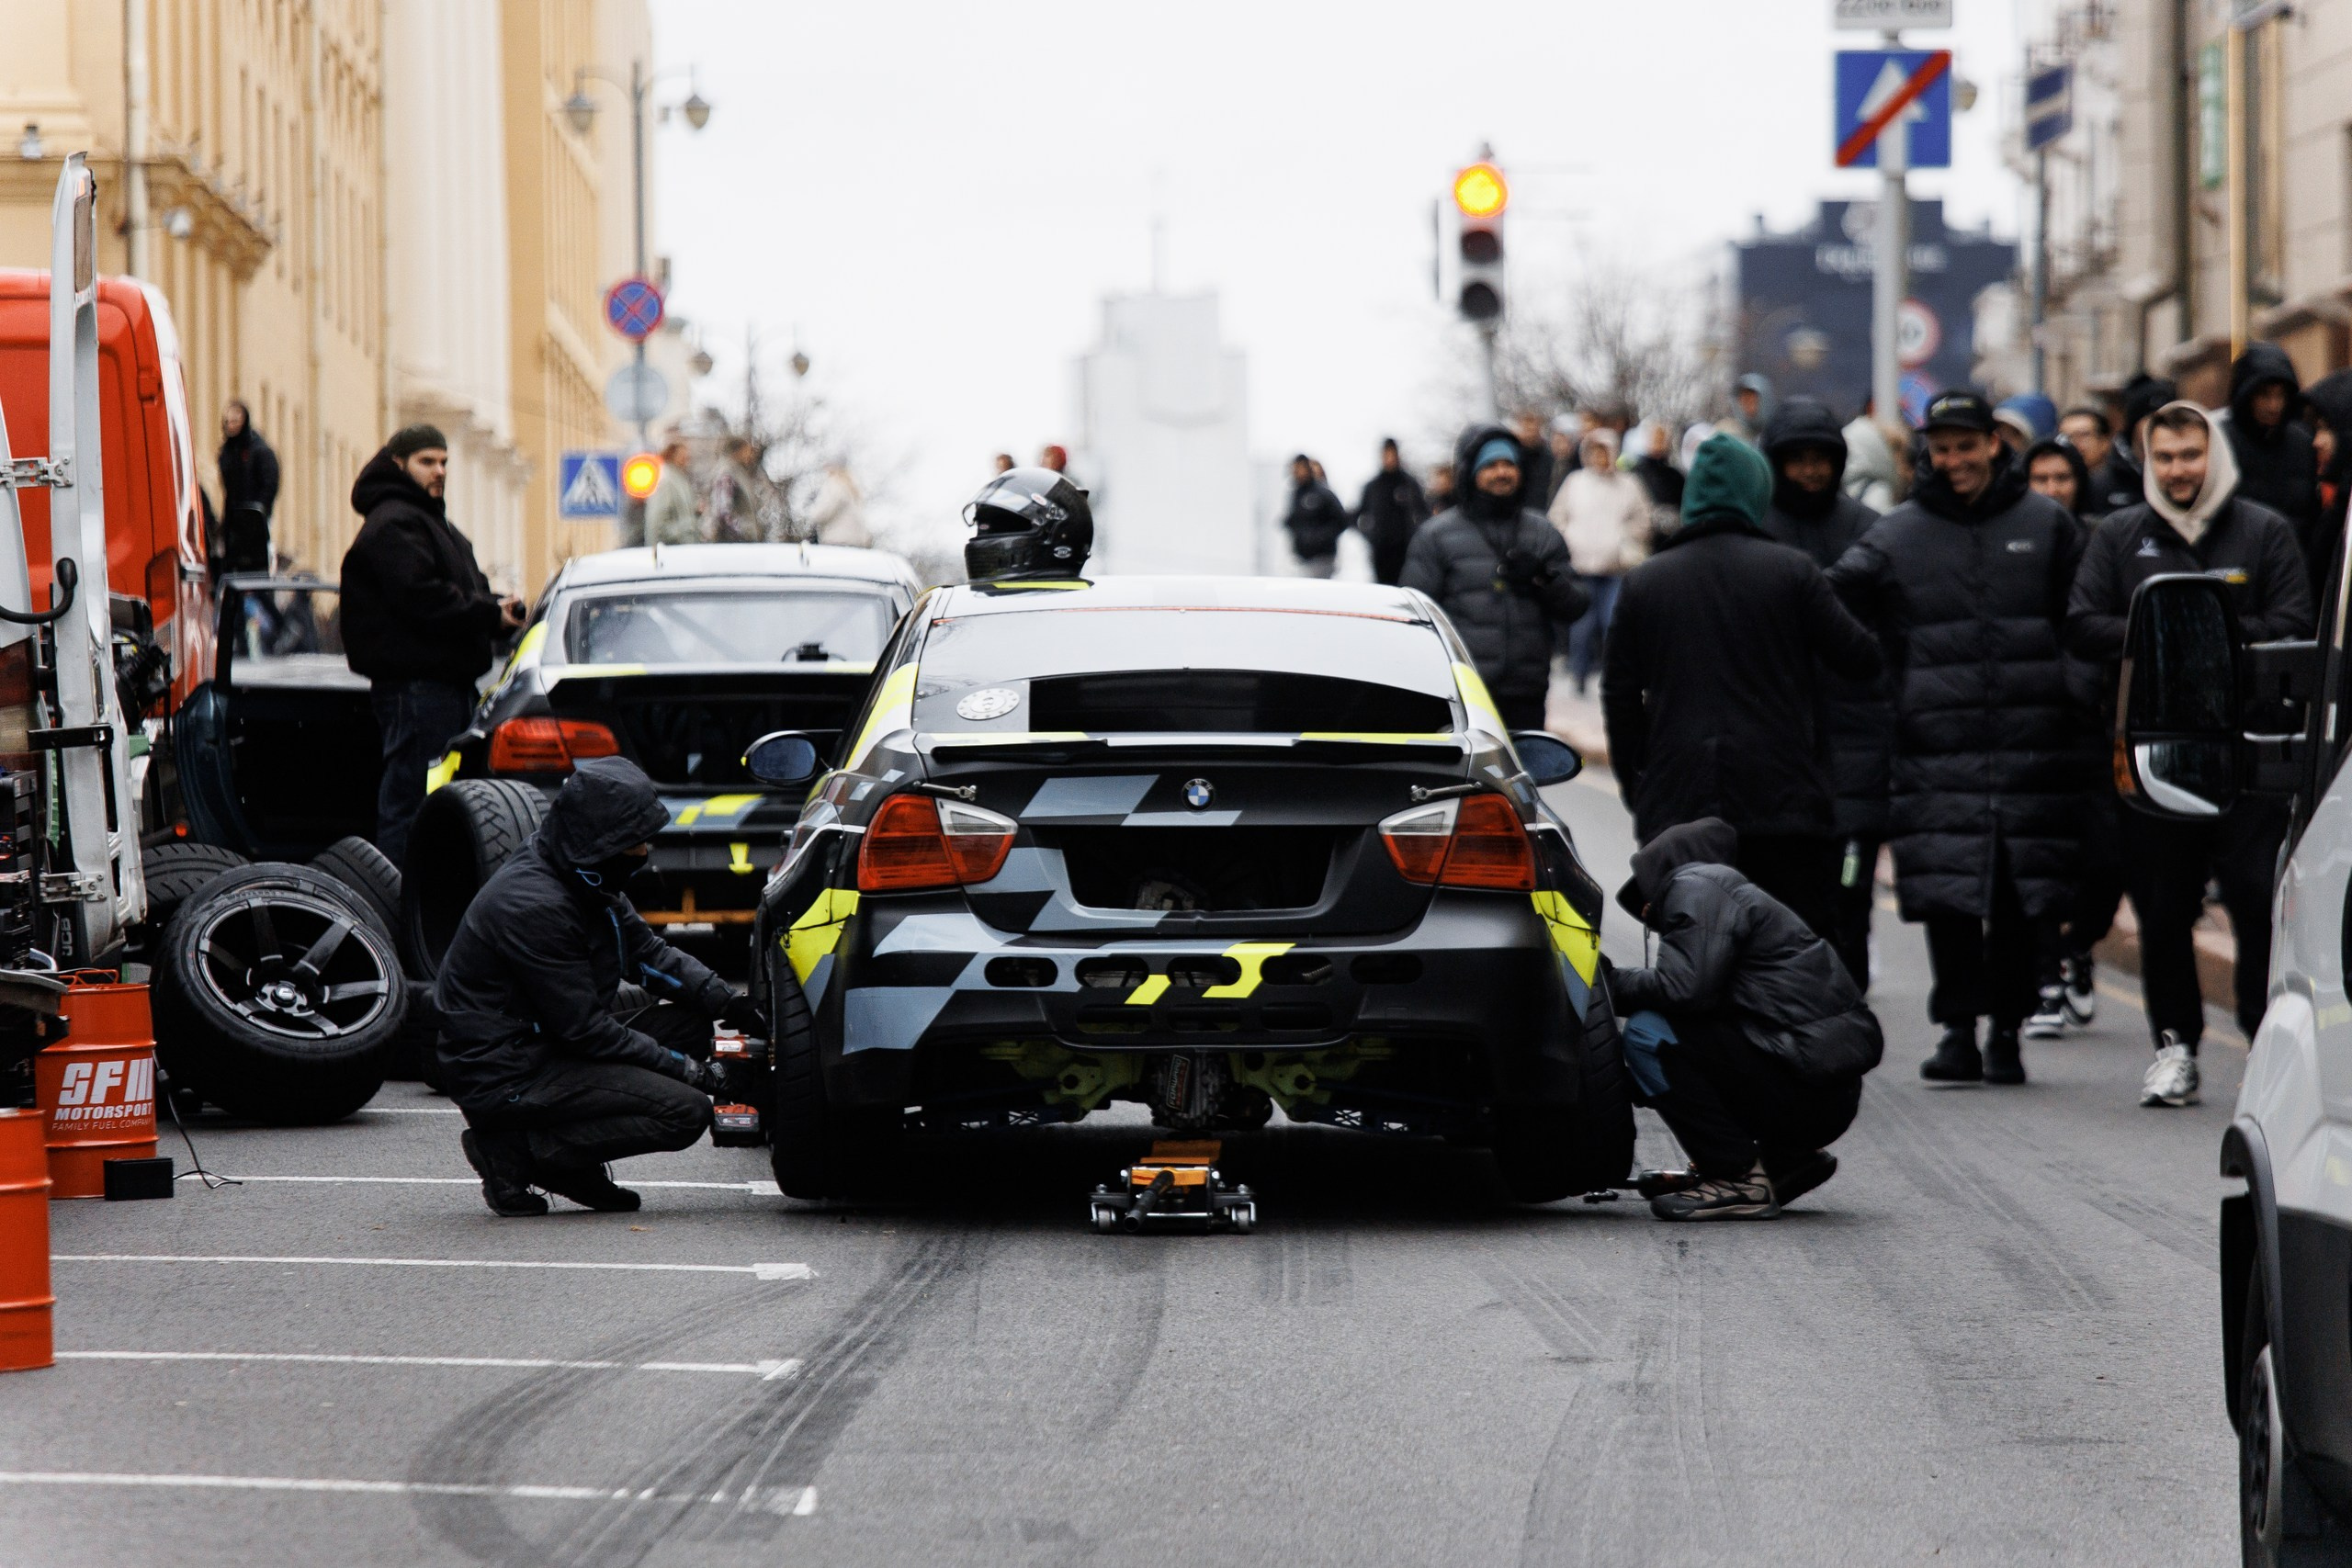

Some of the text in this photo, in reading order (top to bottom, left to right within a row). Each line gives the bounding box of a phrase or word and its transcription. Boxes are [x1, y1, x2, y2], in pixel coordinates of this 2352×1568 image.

[61, 918, 73, 956] JCB
[54, 1102, 153, 1121] MOTORSPORT
[51, 1122, 90, 1131] FAMILY
[92, 1121, 117, 1130] FUEL
